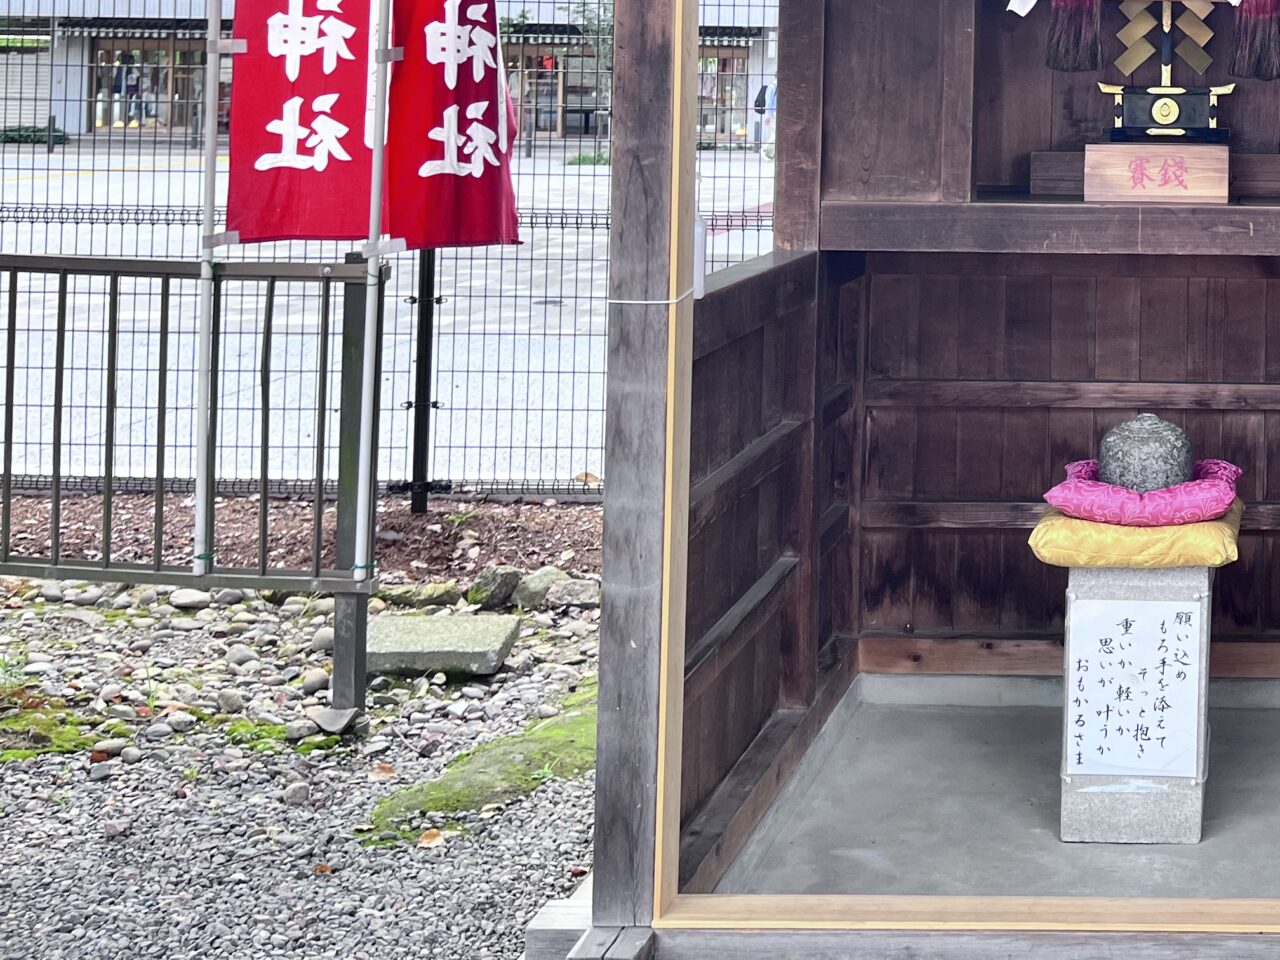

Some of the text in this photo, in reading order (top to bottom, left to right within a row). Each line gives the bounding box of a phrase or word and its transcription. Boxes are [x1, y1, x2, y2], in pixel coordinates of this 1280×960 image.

[1154, 619, 1173, 750] もろ手を添えて
[1173, 611, 1193, 681] 願い込め
[1072, 658, 1089, 766] おもかるさま
[1132, 667, 1152, 759] そっと抱き
